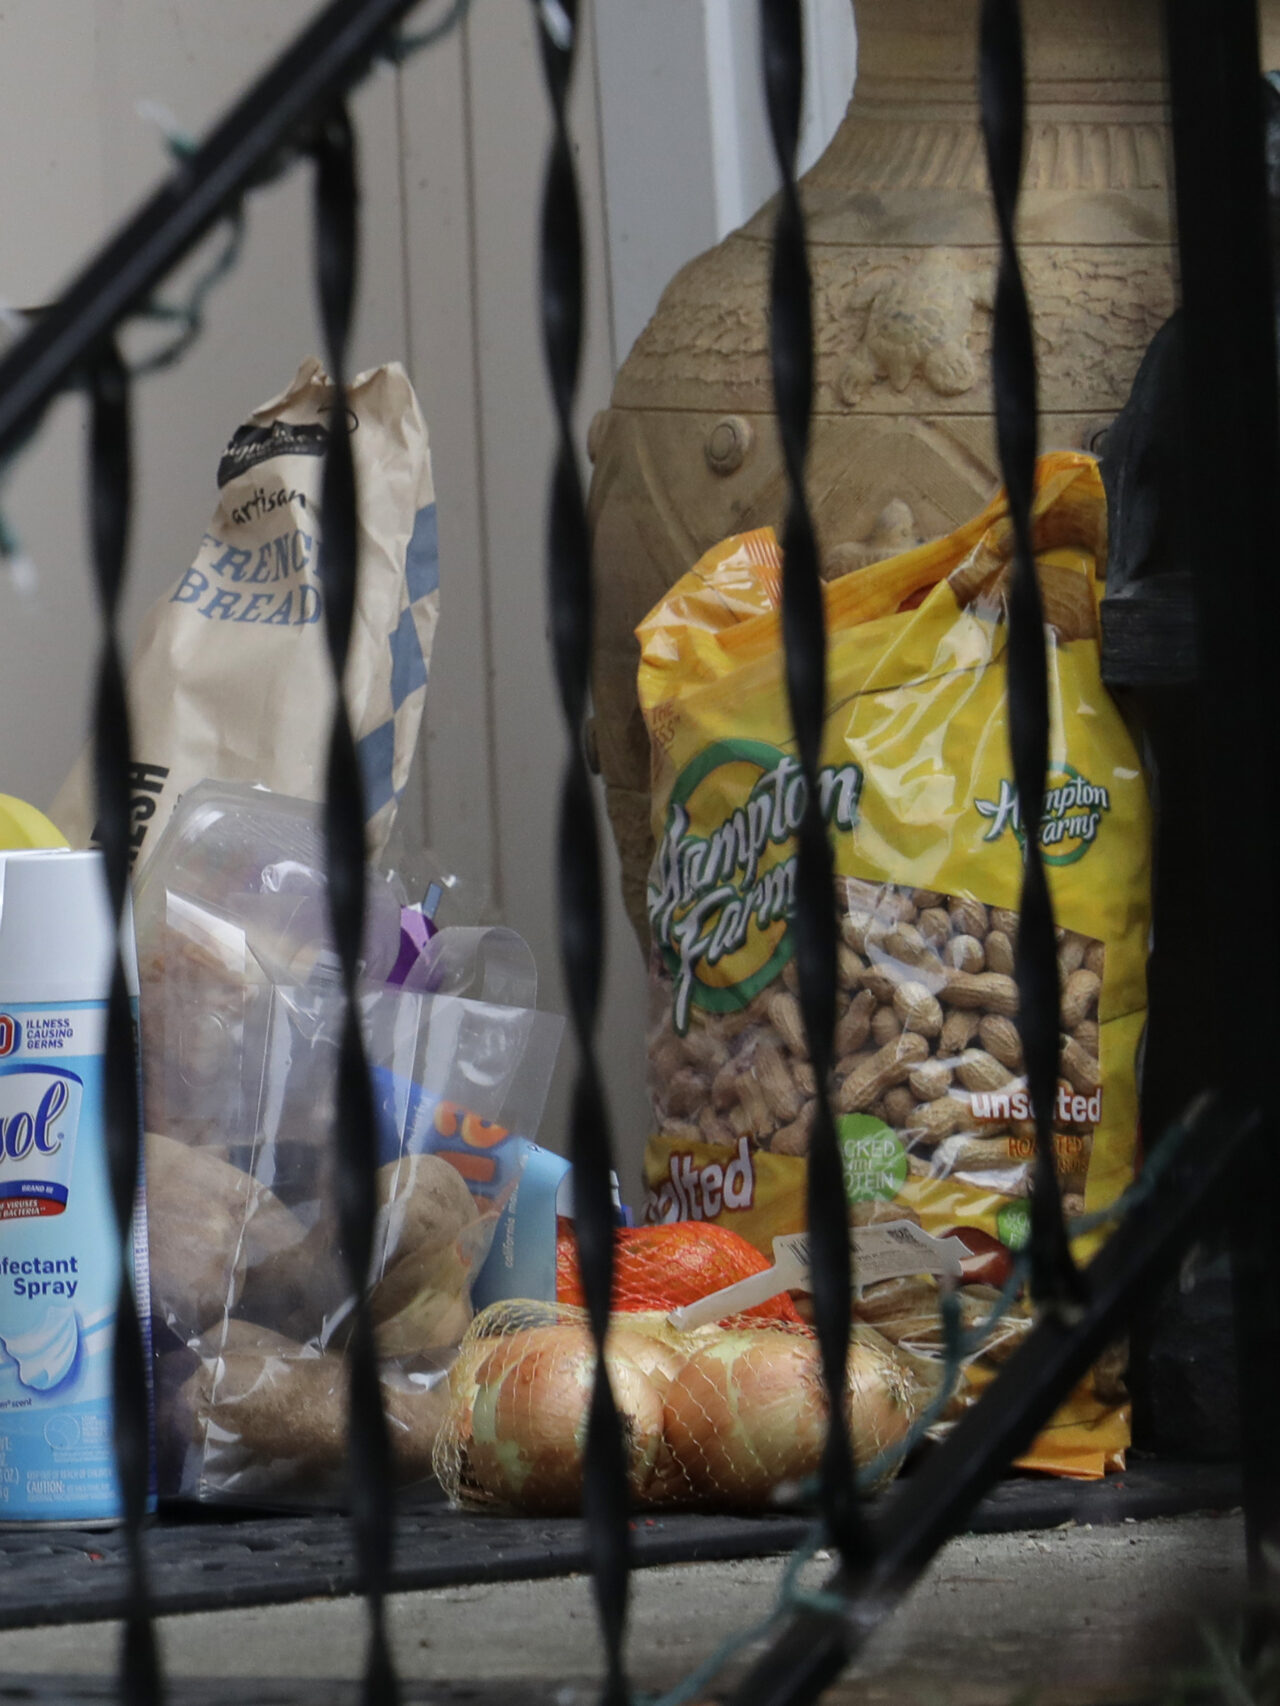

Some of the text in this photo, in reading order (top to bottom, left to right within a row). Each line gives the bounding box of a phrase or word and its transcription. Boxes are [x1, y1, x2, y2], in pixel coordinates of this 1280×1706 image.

[231, 487, 308, 526] artisan
[200, 529, 320, 585] RENC
[170, 568, 322, 627] BREAD
[647, 755, 864, 940] Hampton
[672, 856, 798, 1036] Farm
[26, 1018, 71, 1030] ILLNESS
[26, 1028, 74, 1039] CAUSING
[26, 1039, 65, 1050] GERMS
[843, 1140, 896, 1158] CKED
[1008, 1136, 1084, 1158] ROATED
[6, 1199, 39, 1210] VIRUSES
[13, 1277, 79, 1299] Spray
